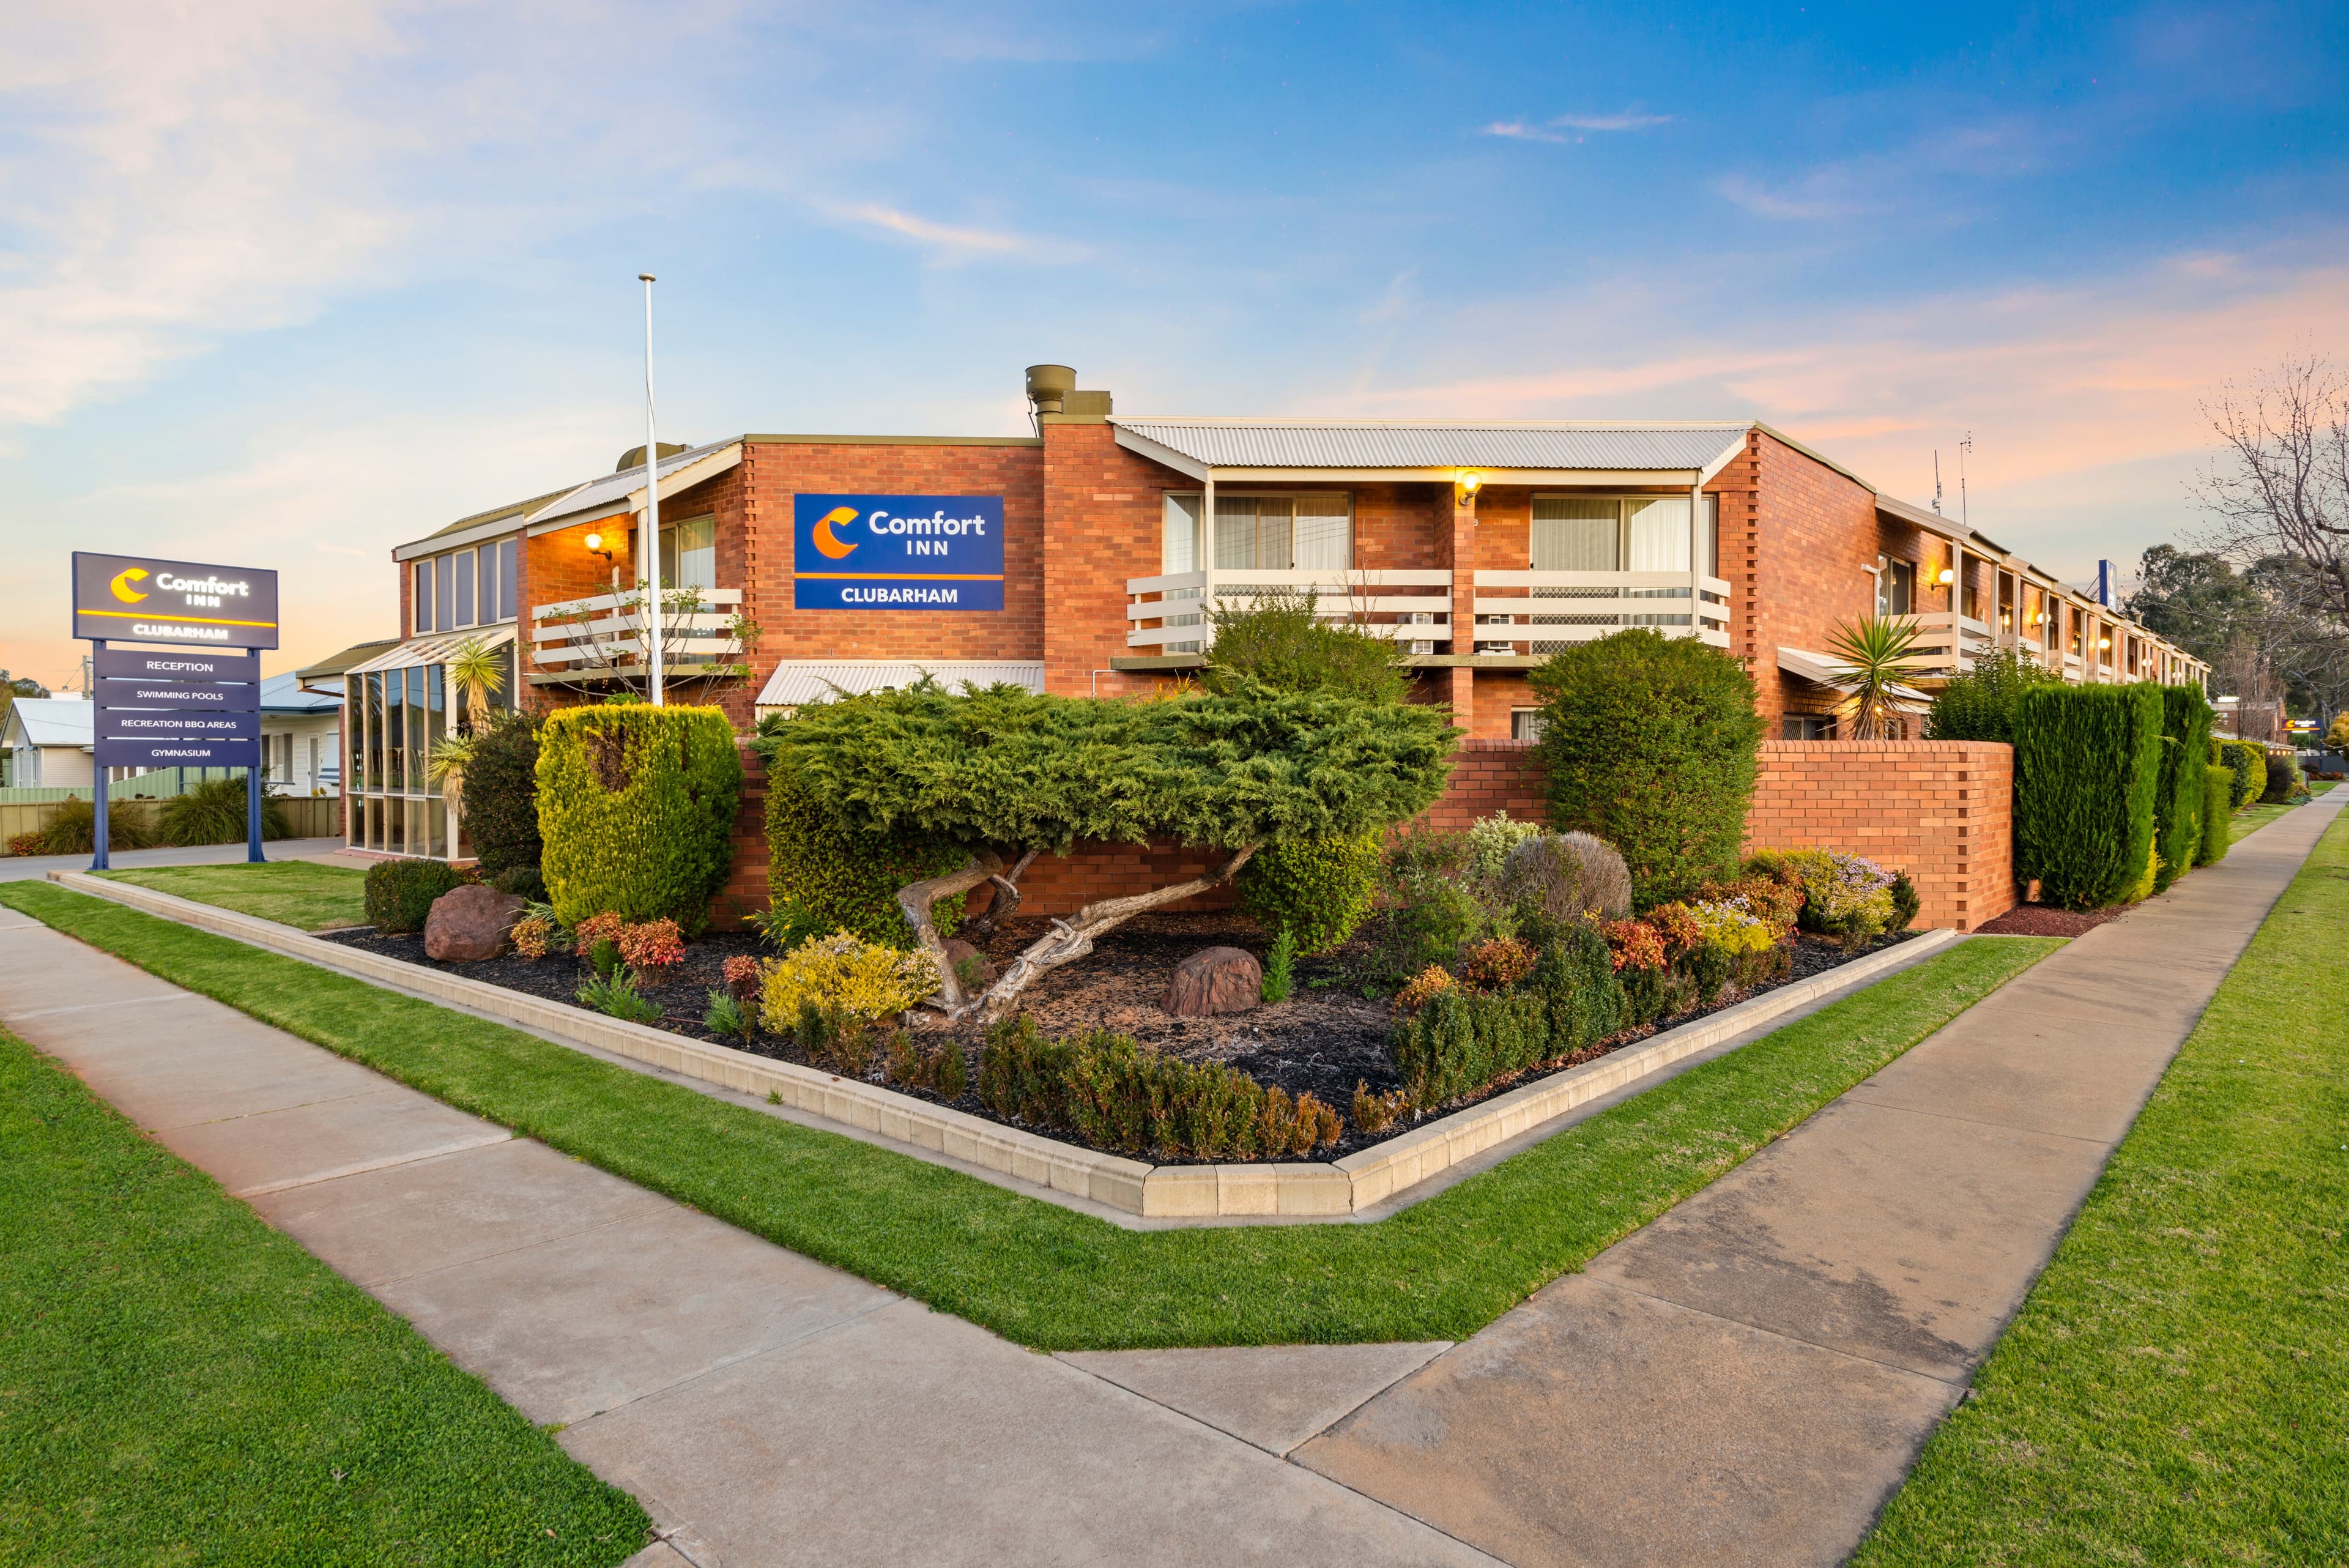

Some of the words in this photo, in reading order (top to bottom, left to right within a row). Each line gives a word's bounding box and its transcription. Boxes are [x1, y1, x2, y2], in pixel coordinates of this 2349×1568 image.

[869, 510, 985, 535] Comfort
[907, 540, 948, 555] INN
[156, 573, 249, 597] Comfort
[186, 593, 221, 608] INN
[841, 587, 958, 603] CLUBARHAM
[133, 623, 229, 640] CLUBARHAM
[146, 661, 213, 672] RECEPTION
[136, 690, 190, 699] SWIMMING
[121, 719, 183, 728] RECREATION
